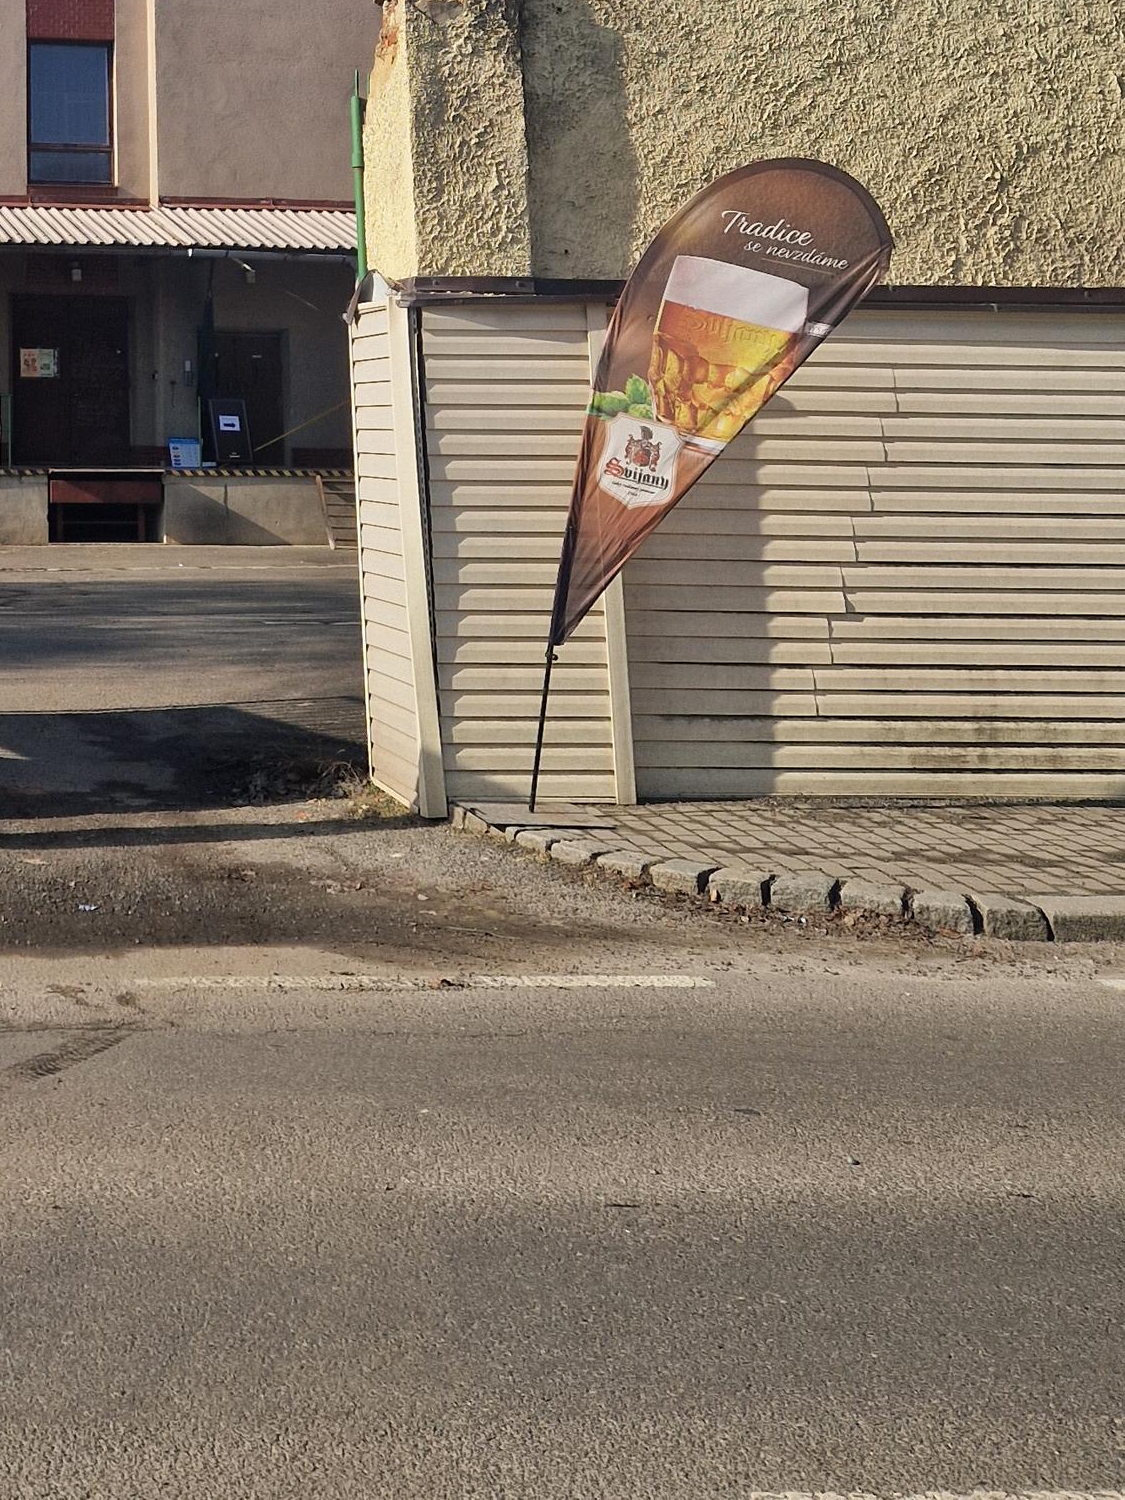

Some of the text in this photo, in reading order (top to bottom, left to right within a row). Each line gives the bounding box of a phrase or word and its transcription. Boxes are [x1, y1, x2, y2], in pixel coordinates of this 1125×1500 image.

[721, 209, 814, 246] Tradice
[743, 240, 850, 270] se nevzdáme
[604, 457, 669, 491] Svijany
